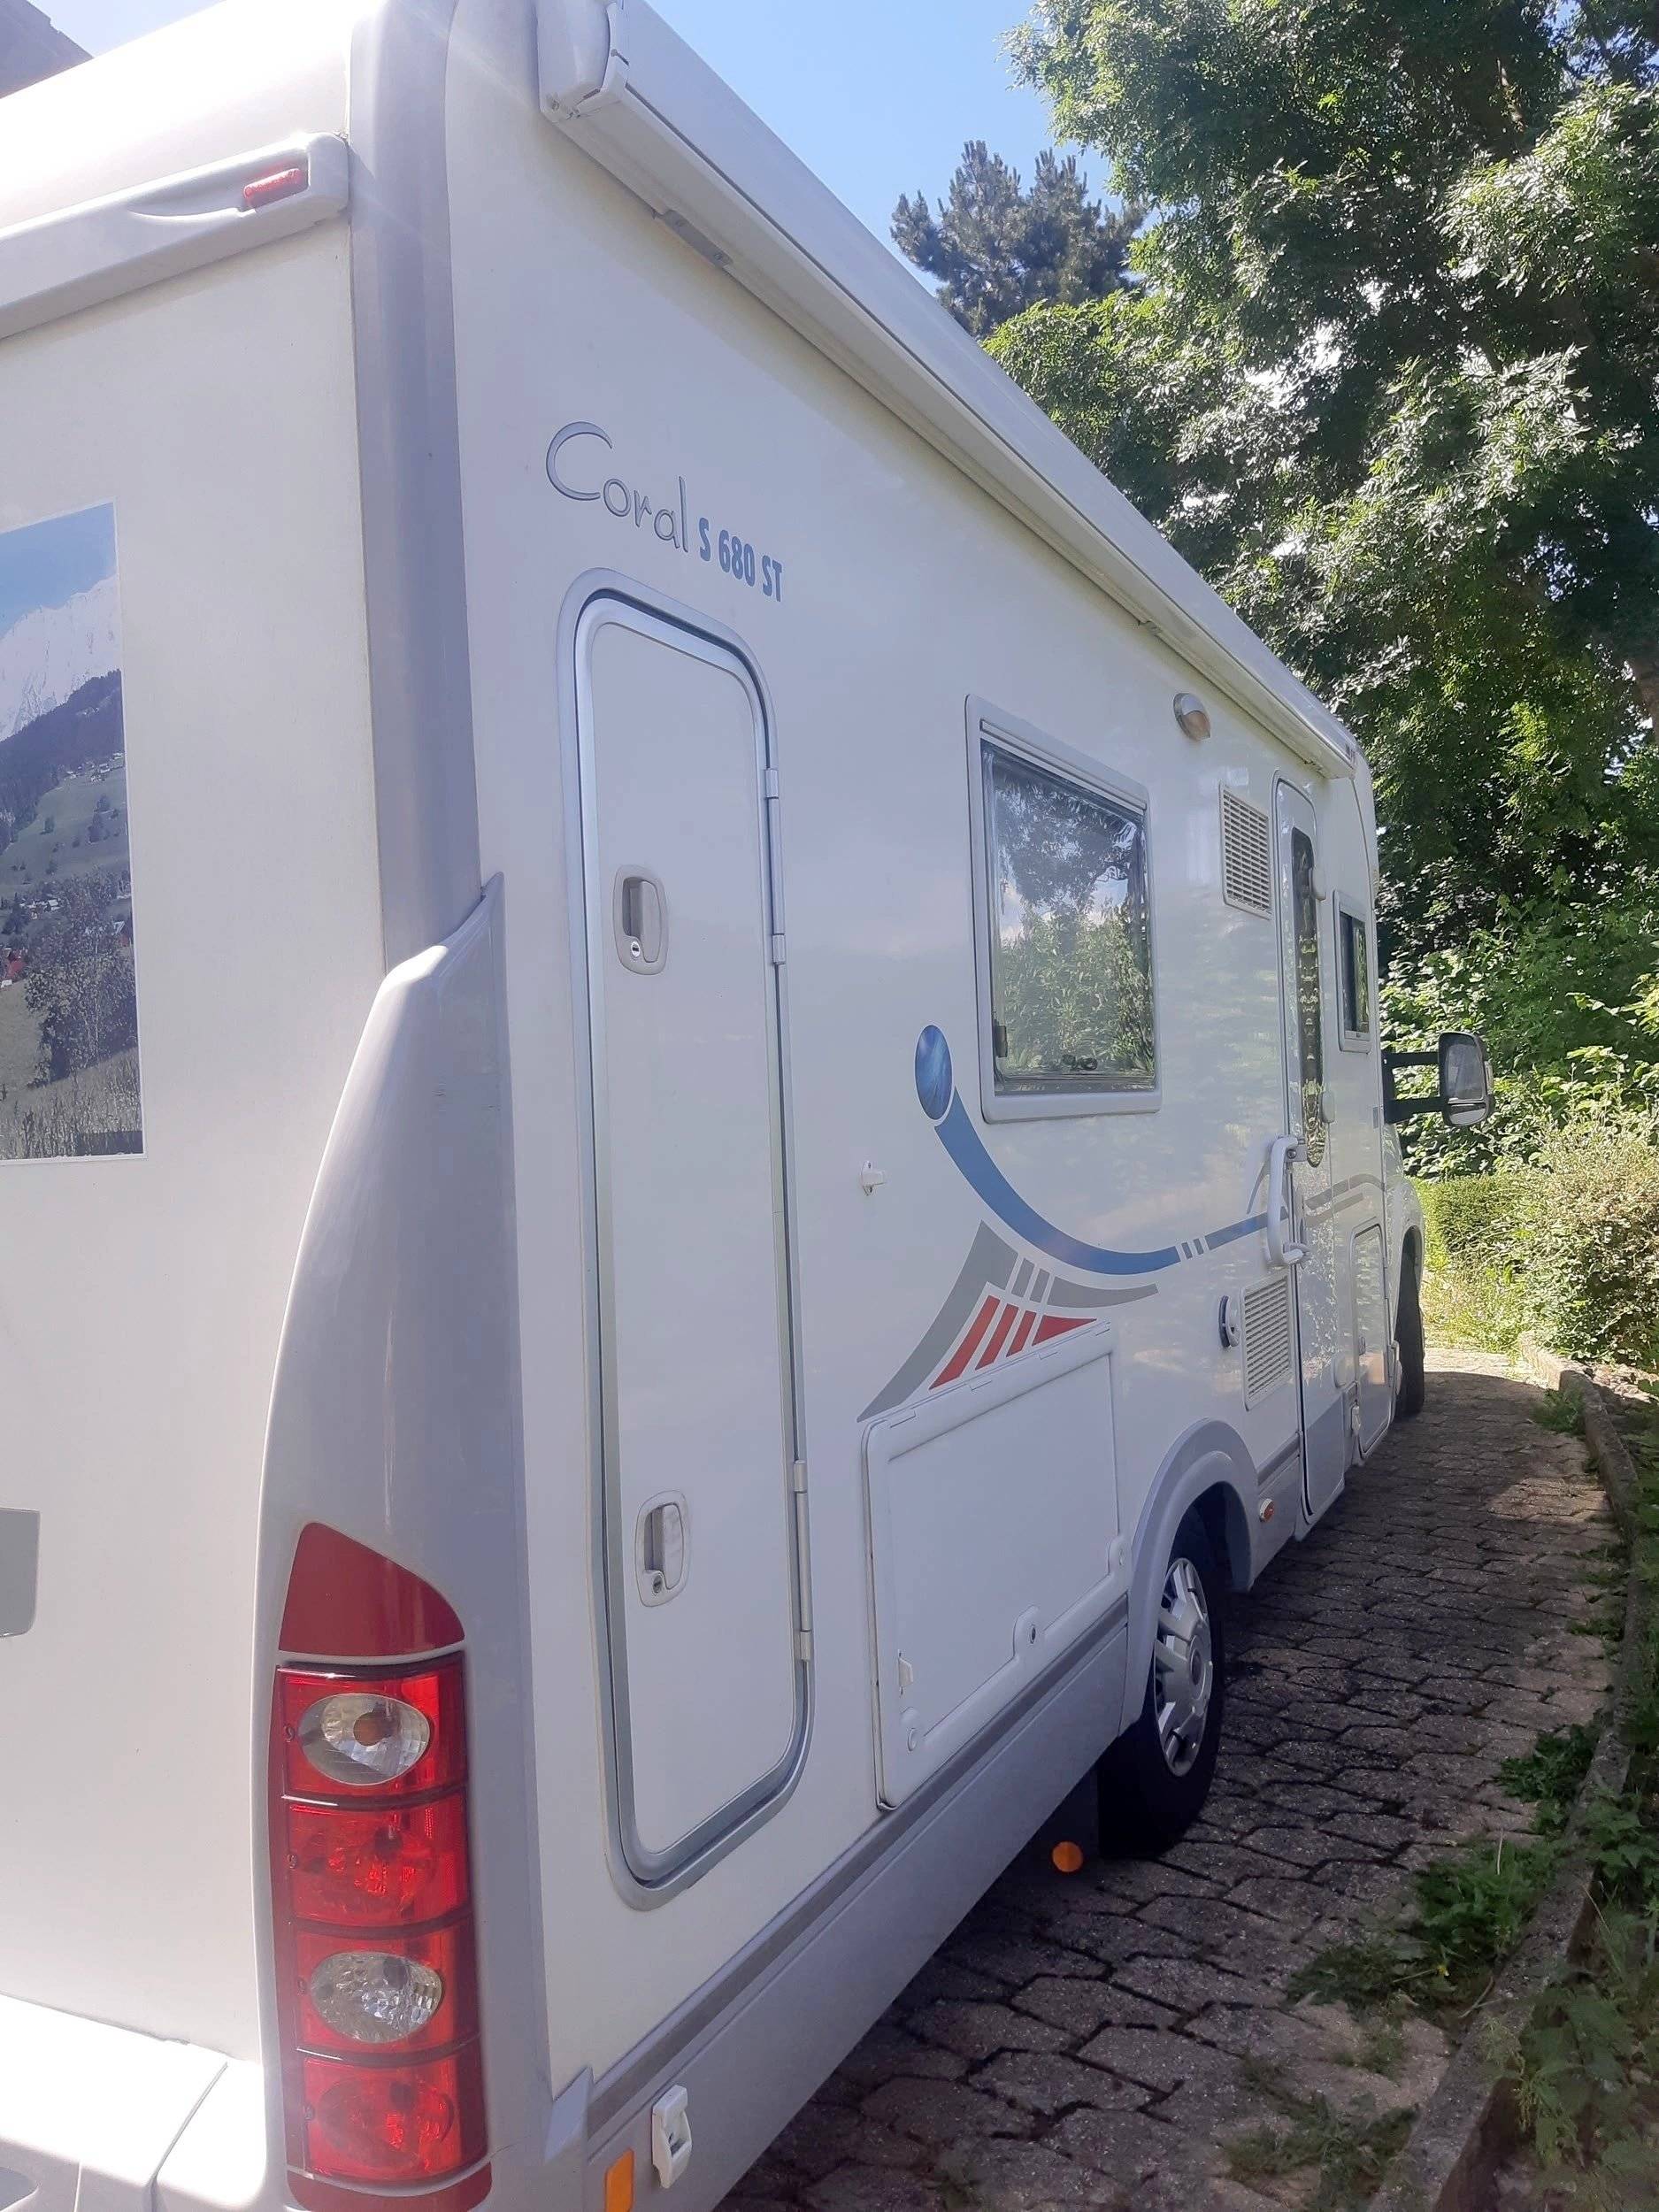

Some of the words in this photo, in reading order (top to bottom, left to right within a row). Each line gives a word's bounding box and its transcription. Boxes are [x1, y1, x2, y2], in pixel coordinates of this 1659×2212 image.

[546, 421, 688, 553] Coral
[699, 518, 711, 562] S
[718, 529, 756, 588] 680
[762, 555, 783, 602] ST
